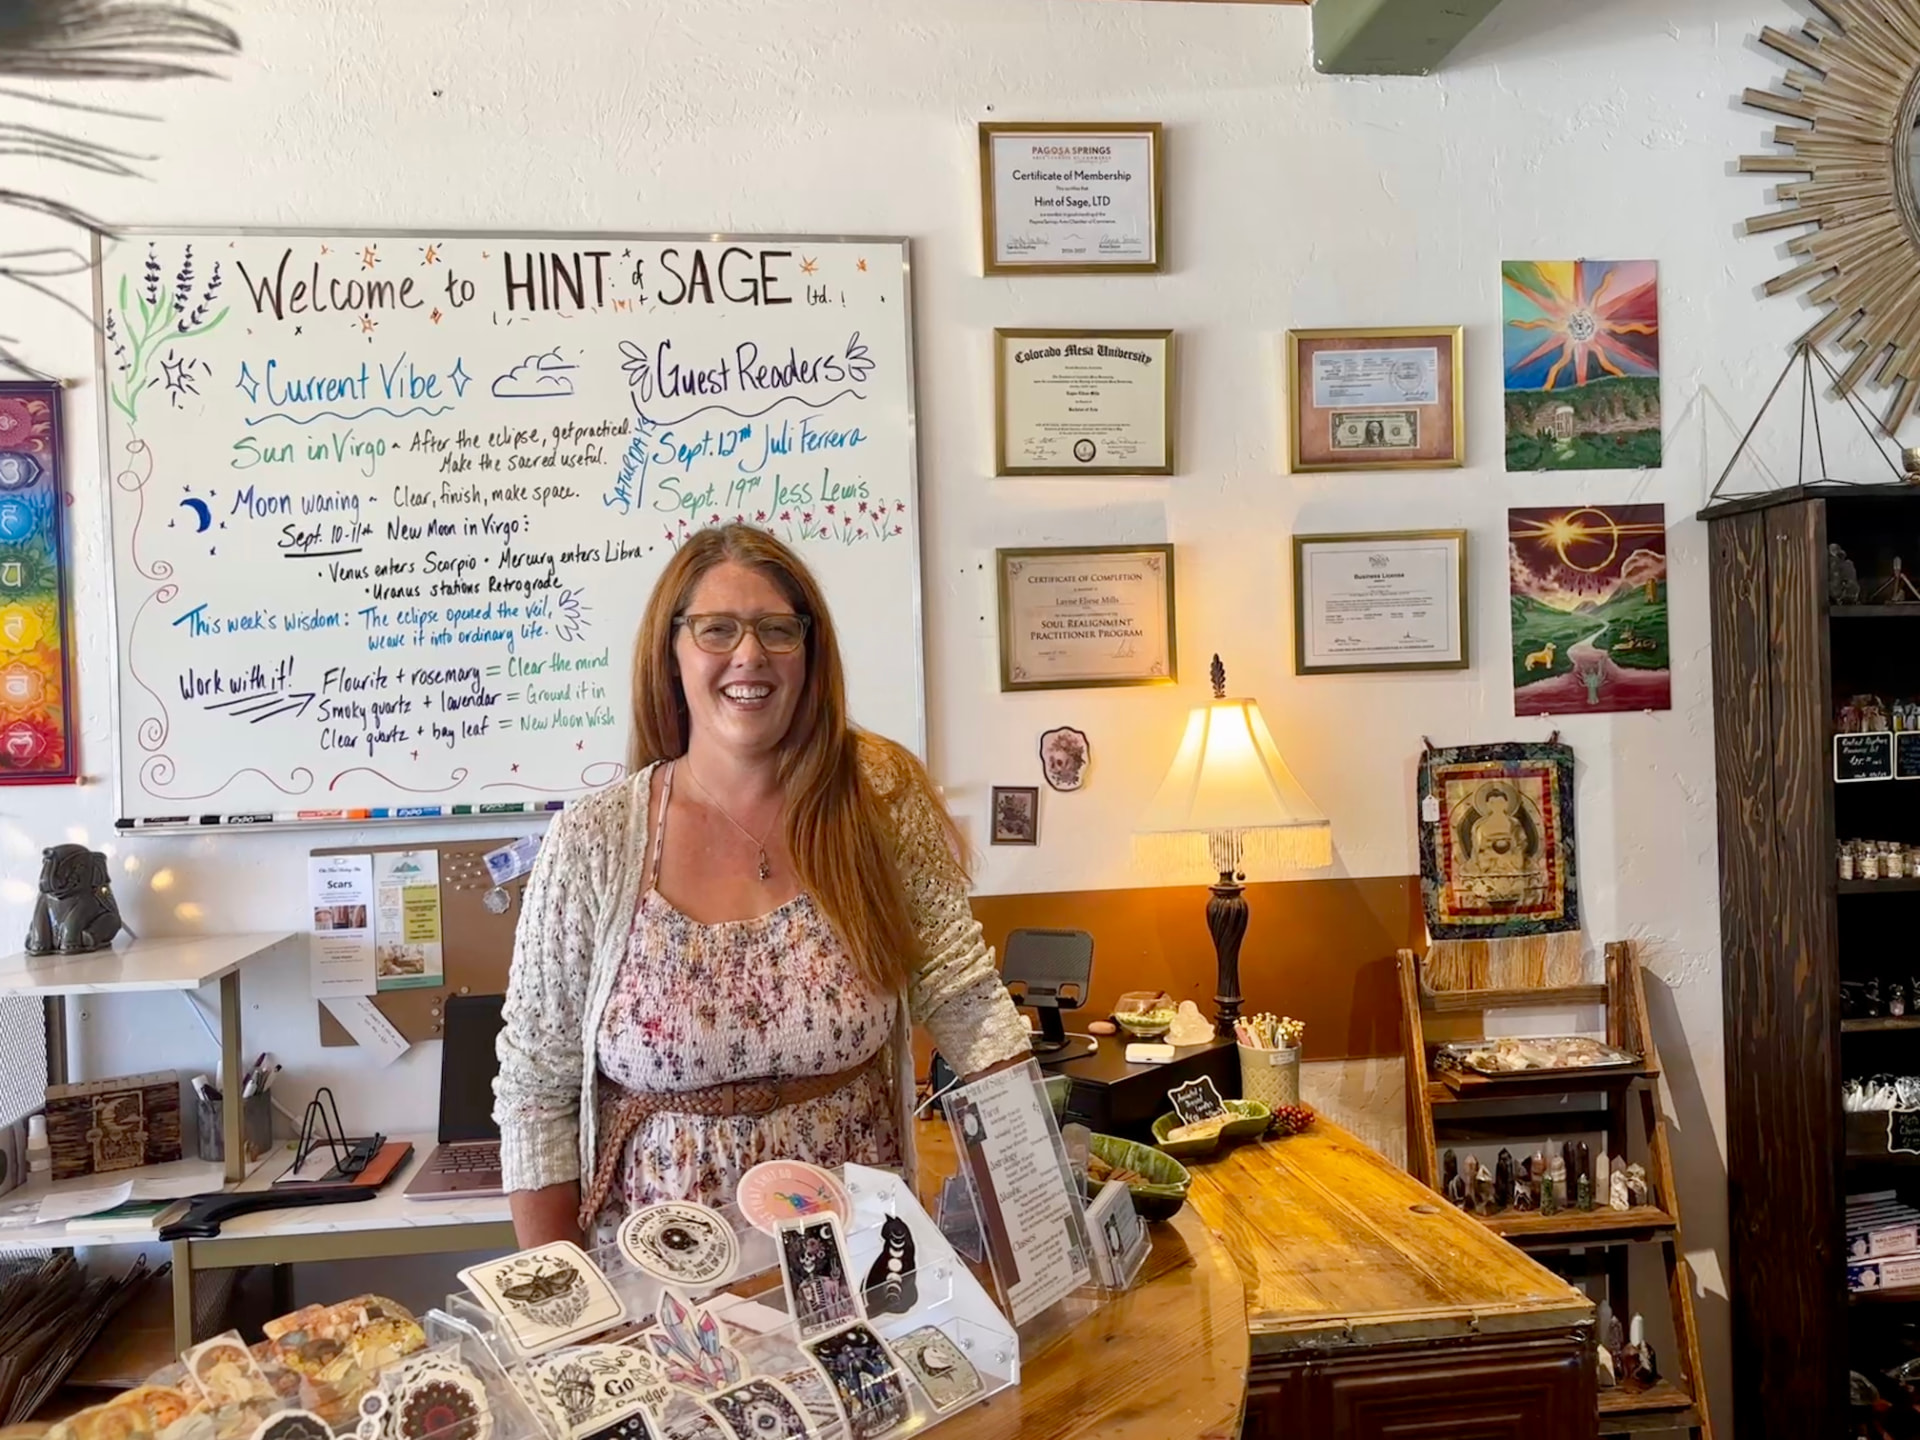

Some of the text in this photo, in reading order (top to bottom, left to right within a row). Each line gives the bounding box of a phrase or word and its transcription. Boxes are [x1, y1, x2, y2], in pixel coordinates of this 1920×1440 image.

[1032, 146, 1111, 155] PAGOSA SPRINGS
[1012, 169, 1131, 182] Certificate of Membership
[1034, 196, 1111, 208] Hint of Sage, LTD
[236, 248, 424, 320] Welcome
[445, 268, 475, 307] to
[504, 250, 612, 312] HINT
[658, 247, 793, 306] SAGE
[657, 339, 845, 398] Guest Readers
[1014, 344, 1152, 365] Colorado Mesa University
[266, 352, 443, 407] Current Vibe
[231, 436, 294, 469] Sun
[308, 435, 329, 461] in
[332, 428, 386, 477] Virgo
[409, 429, 451, 453] After
[456, 429, 481, 449] the
[488, 425, 547, 449] eclipse,
[439, 443, 608, 474] Make the sacred useful.
[652, 430, 715, 473] Sept.
[738, 419, 796, 473] Juli
[800, 414, 868, 454] Ferrera
[231, 481, 581, 525] Moon waning Clear, finish, make space.
[653, 476, 719, 520] Sept.
[762, 474, 813, 523] Jess
[820, 467, 870, 503] Lewis
[277, 523, 322, 552] Sept.
[387, 516, 422, 540] New
[427, 519, 456, 537] Moon
[463, 517, 477, 536] in
[329, 539, 643, 583] Venus enters Scorpio Mercury enters Libra
[1028, 573, 1143, 584] CERTIFICATE OF COMPLETION
[373, 570, 563, 600] Uranus stations Retrograde
[170, 603, 221, 638] This
[227, 609, 277, 633] week's
[358, 605, 389, 630] The
[397, 606, 439, 628] eclipse
[446, 601, 492, 628] opened
[497, 600, 519, 619] the
[1030, 629, 1143, 640] PRACTITIONER PROGRAM
[1041, 620, 1065, 629] SOUL
[368, 621, 549, 654] weave it into ordinary life.
[179, 655, 294, 700] Work with it!
[411, 666, 480, 694] rosemary
[508, 656, 548, 678] Clear
[549, 652, 572, 671] the
[575, 647, 609, 669] mind
[317, 699, 367, 731] Smoky
[371, 694, 412, 729] quartz
[526, 683, 571, 705] Ground
[575, 683, 588, 700] it
[591, 682, 606, 698] in
[320, 727, 358, 750] Clear
[366, 724, 409, 757] quartz
[432, 722, 455, 749] bay
[461, 715, 490, 737] leaf
[520, 715, 548, 731] New
[551, 710, 584, 729] Moon
[587, 706, 615, 726] Wish
[327, 880, 353, 889] Scars
[1013, 1233, 1036, 1252] Classes
[604, 1377, 635, 1396] Go
